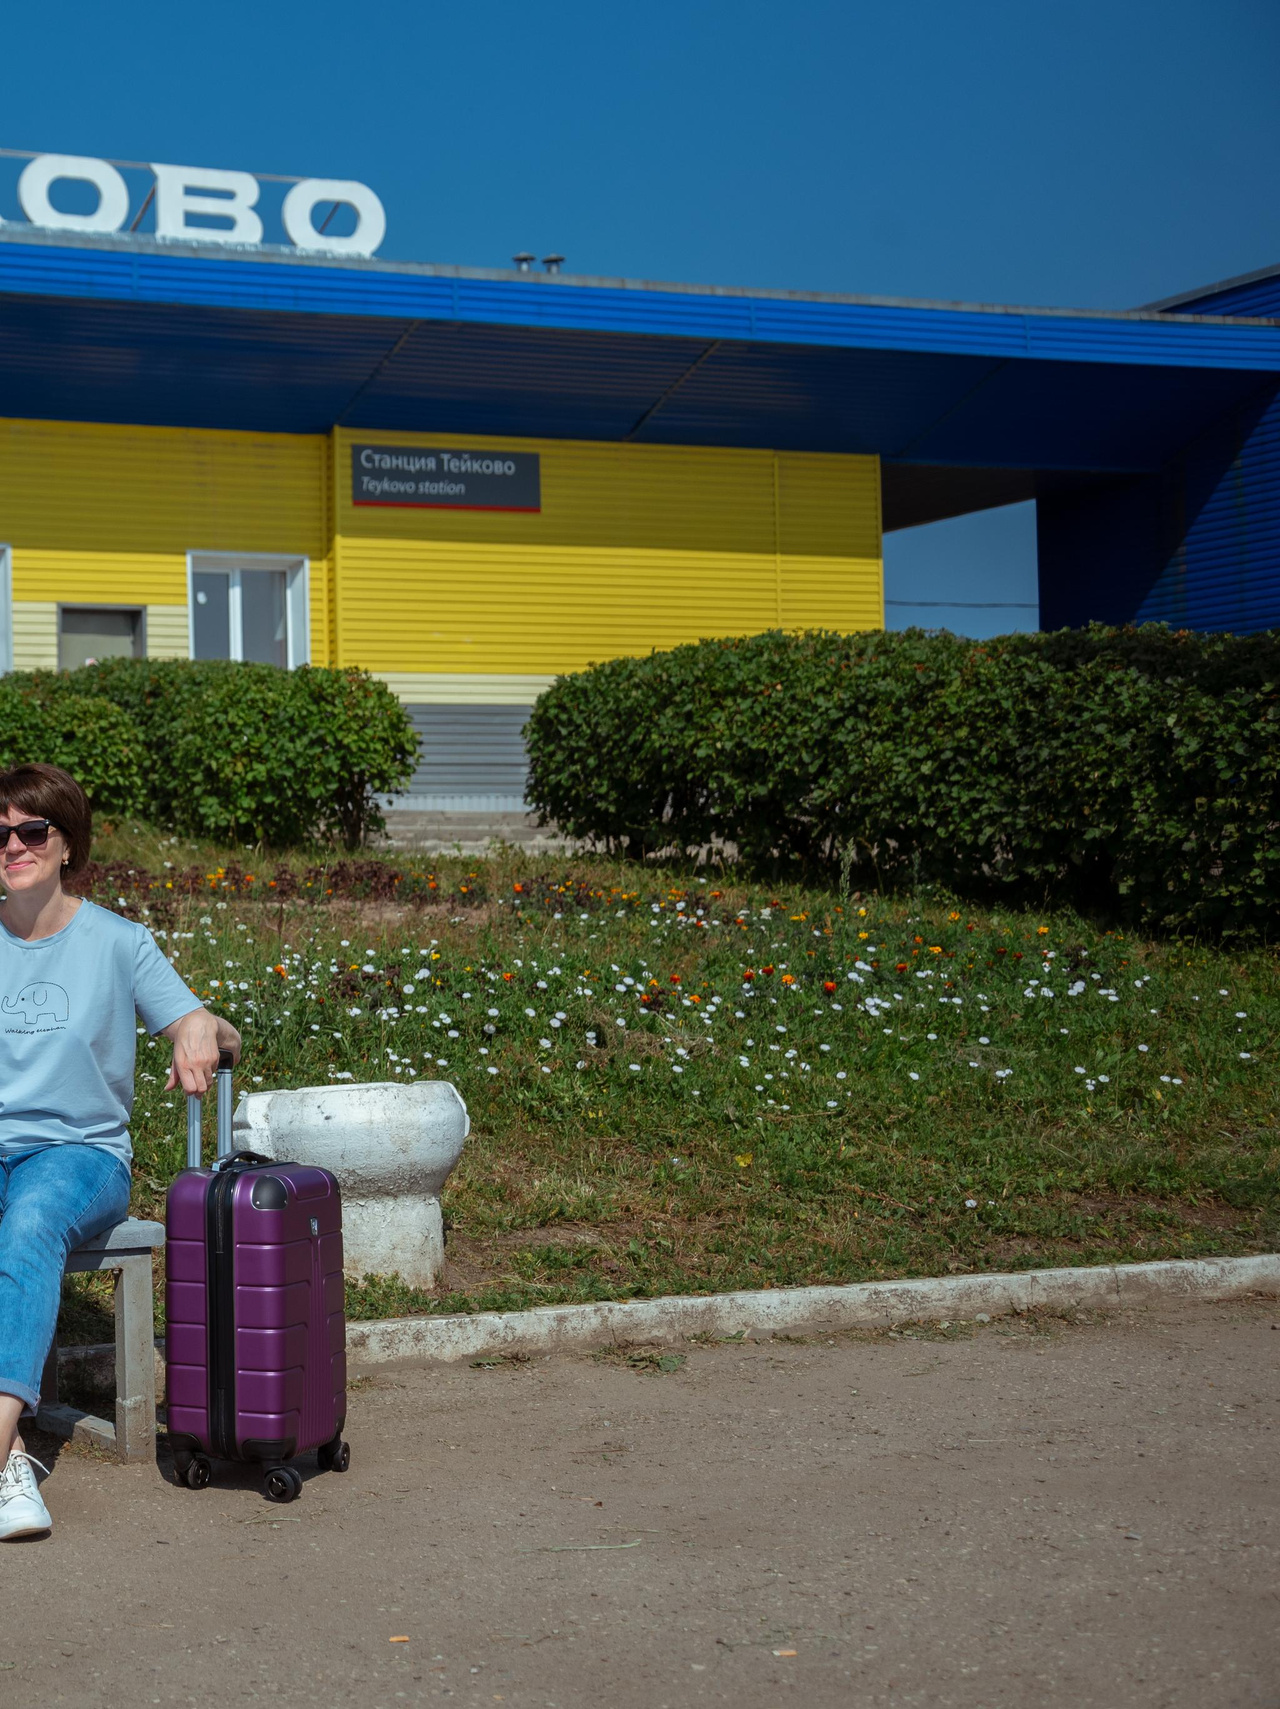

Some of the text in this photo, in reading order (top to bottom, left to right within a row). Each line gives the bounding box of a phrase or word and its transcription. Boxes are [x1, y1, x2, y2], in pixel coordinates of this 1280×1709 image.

[360, 449, 516, 475] Станция Тейково
[361, 476, 466, 496] Teykovo station
